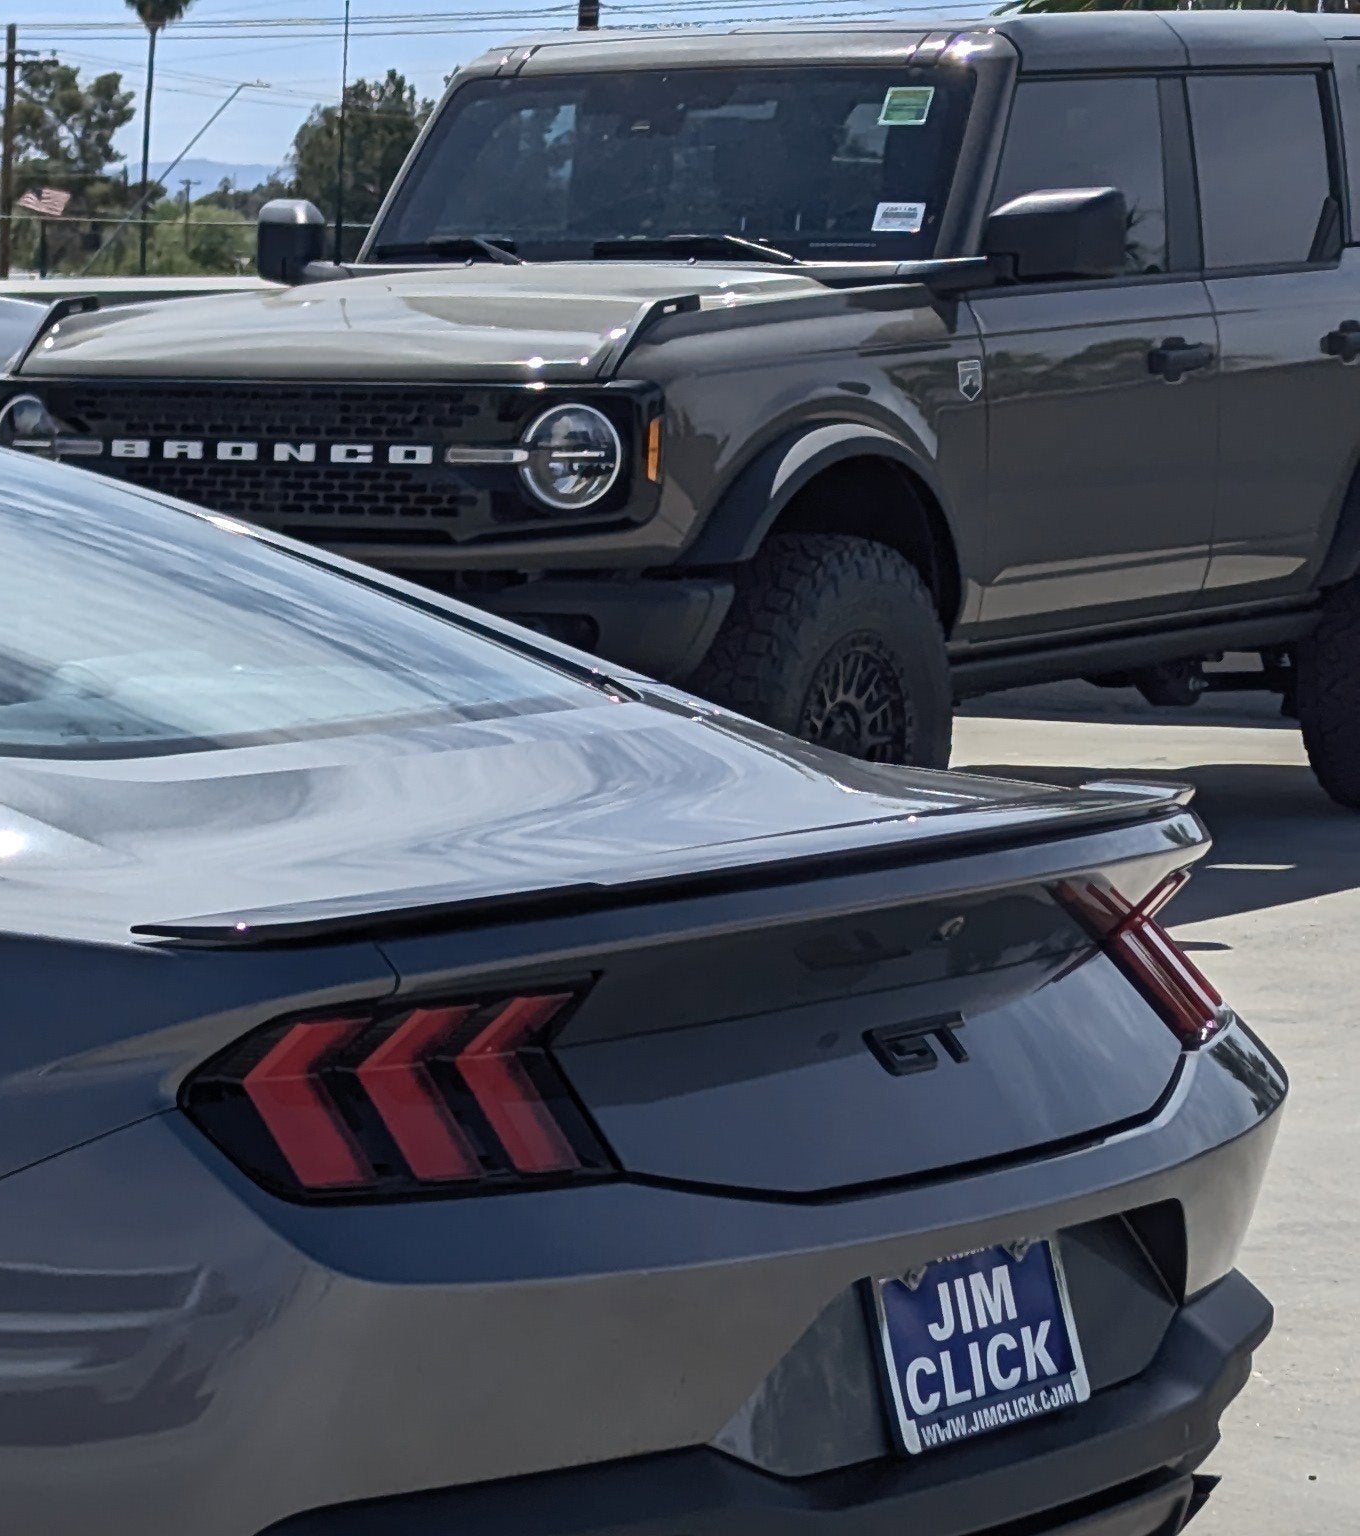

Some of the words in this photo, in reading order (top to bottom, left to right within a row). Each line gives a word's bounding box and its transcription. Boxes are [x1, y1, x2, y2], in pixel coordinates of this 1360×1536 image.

[110, 439, 434, 465] BRONCO
[862, 1010, 970, 1077] GT
[927, 1264, 1019, 1342] JIM
[905, 1320, 1059, 1416] CLICK
